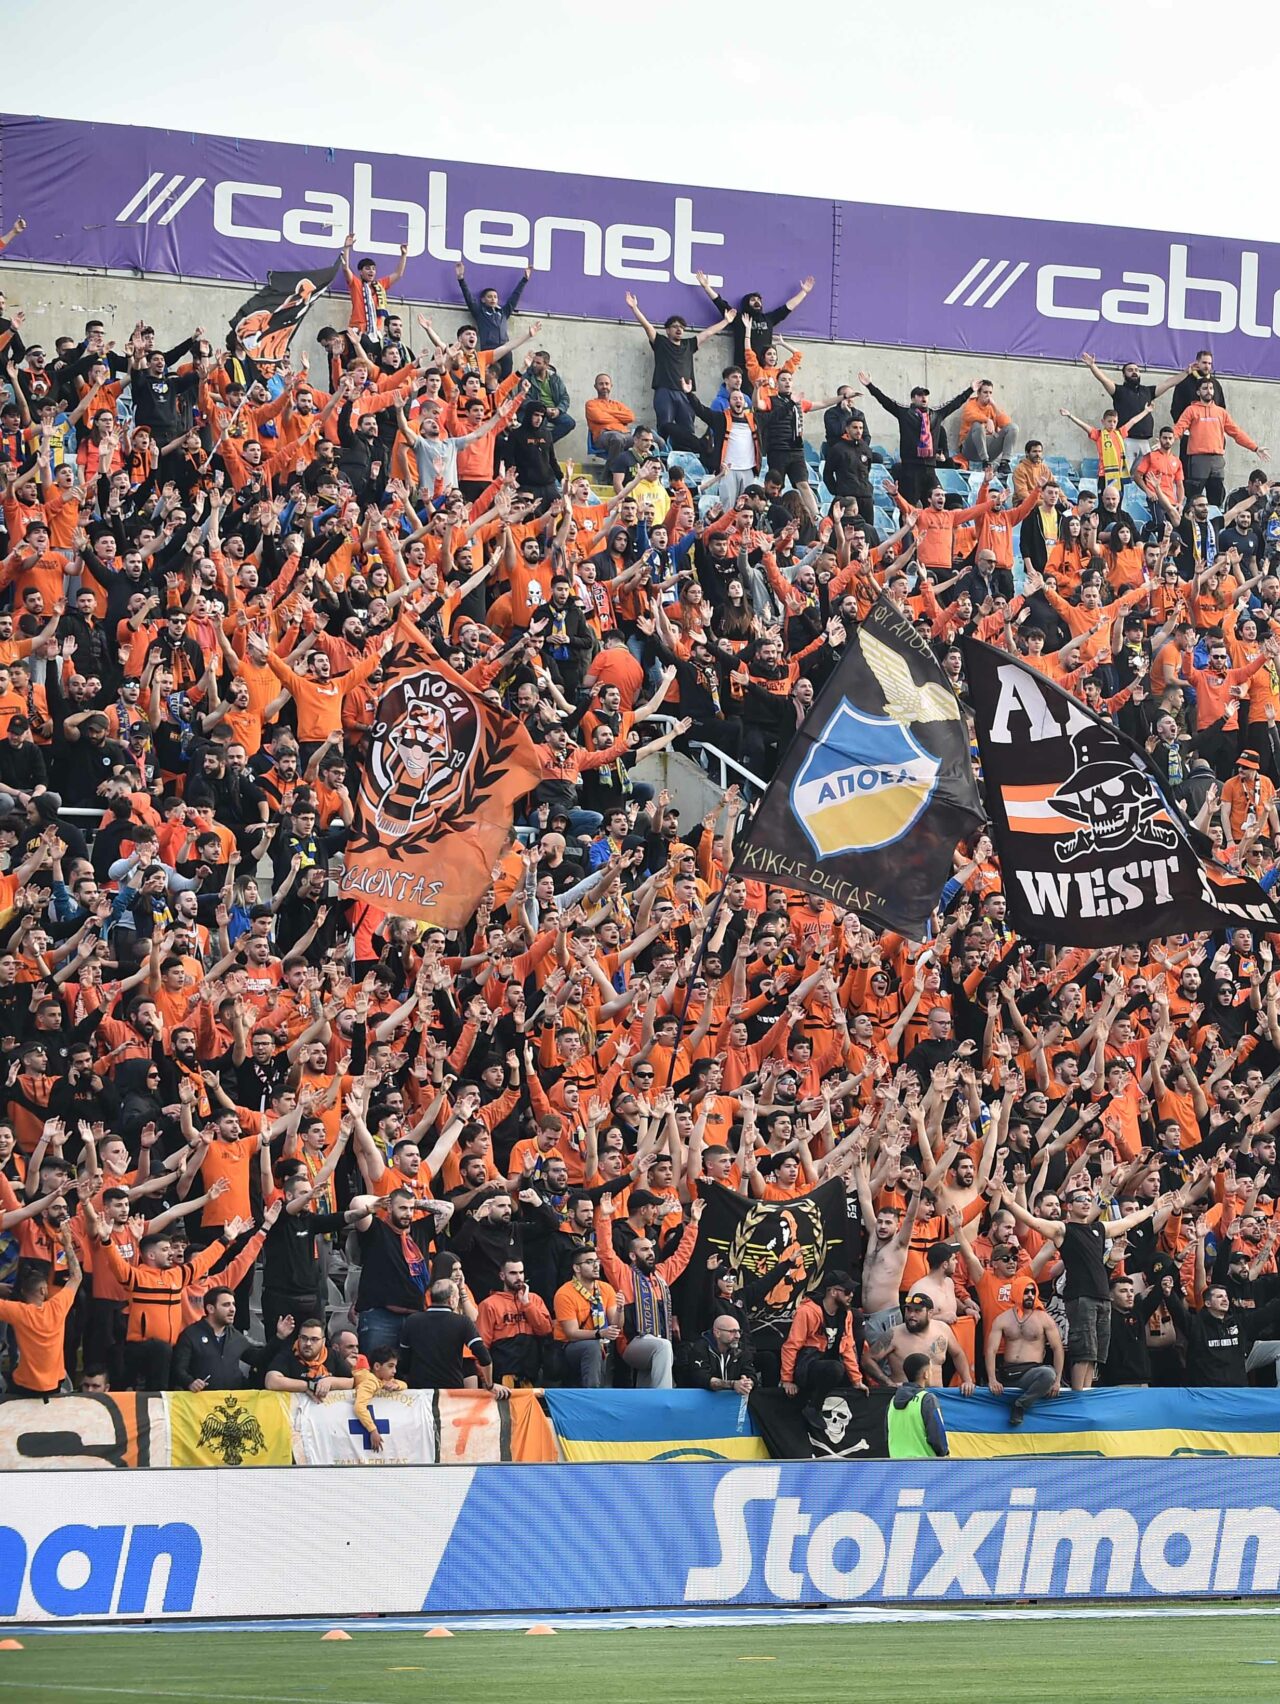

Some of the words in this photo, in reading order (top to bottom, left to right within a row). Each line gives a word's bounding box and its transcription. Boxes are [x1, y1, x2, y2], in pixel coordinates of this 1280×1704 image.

[214, 162, 725, 299] cablenet
[403, 678, 470, 722] ΑΠΟΕΛ
[450, 749, 466, 768] 79
[818, 768, 918, 804] ΑΠΟΕΛ
[1016, 856, 1180, 918] WEST
[0, 1523, 202, 1616] an
